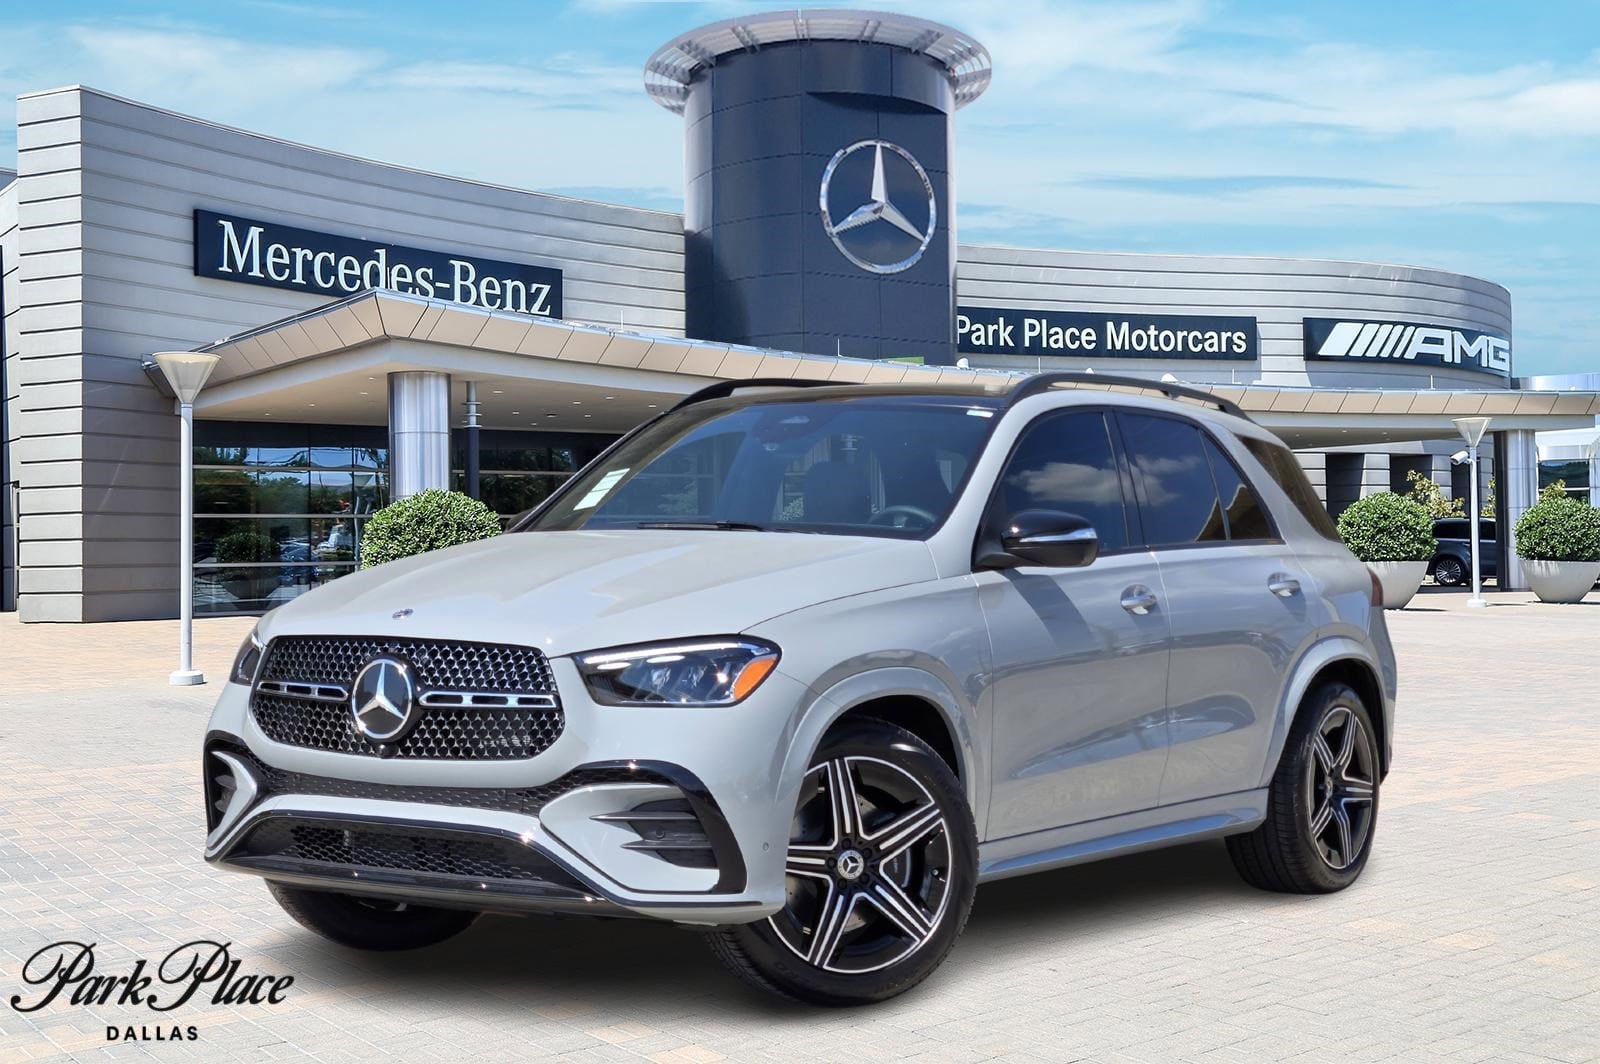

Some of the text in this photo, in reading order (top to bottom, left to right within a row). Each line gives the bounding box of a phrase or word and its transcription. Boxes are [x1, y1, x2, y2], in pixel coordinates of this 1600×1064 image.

[217, 219, 553, 316] Mercedes-Benz
[956, 314, 1247, 353] Park Place Motorcars
